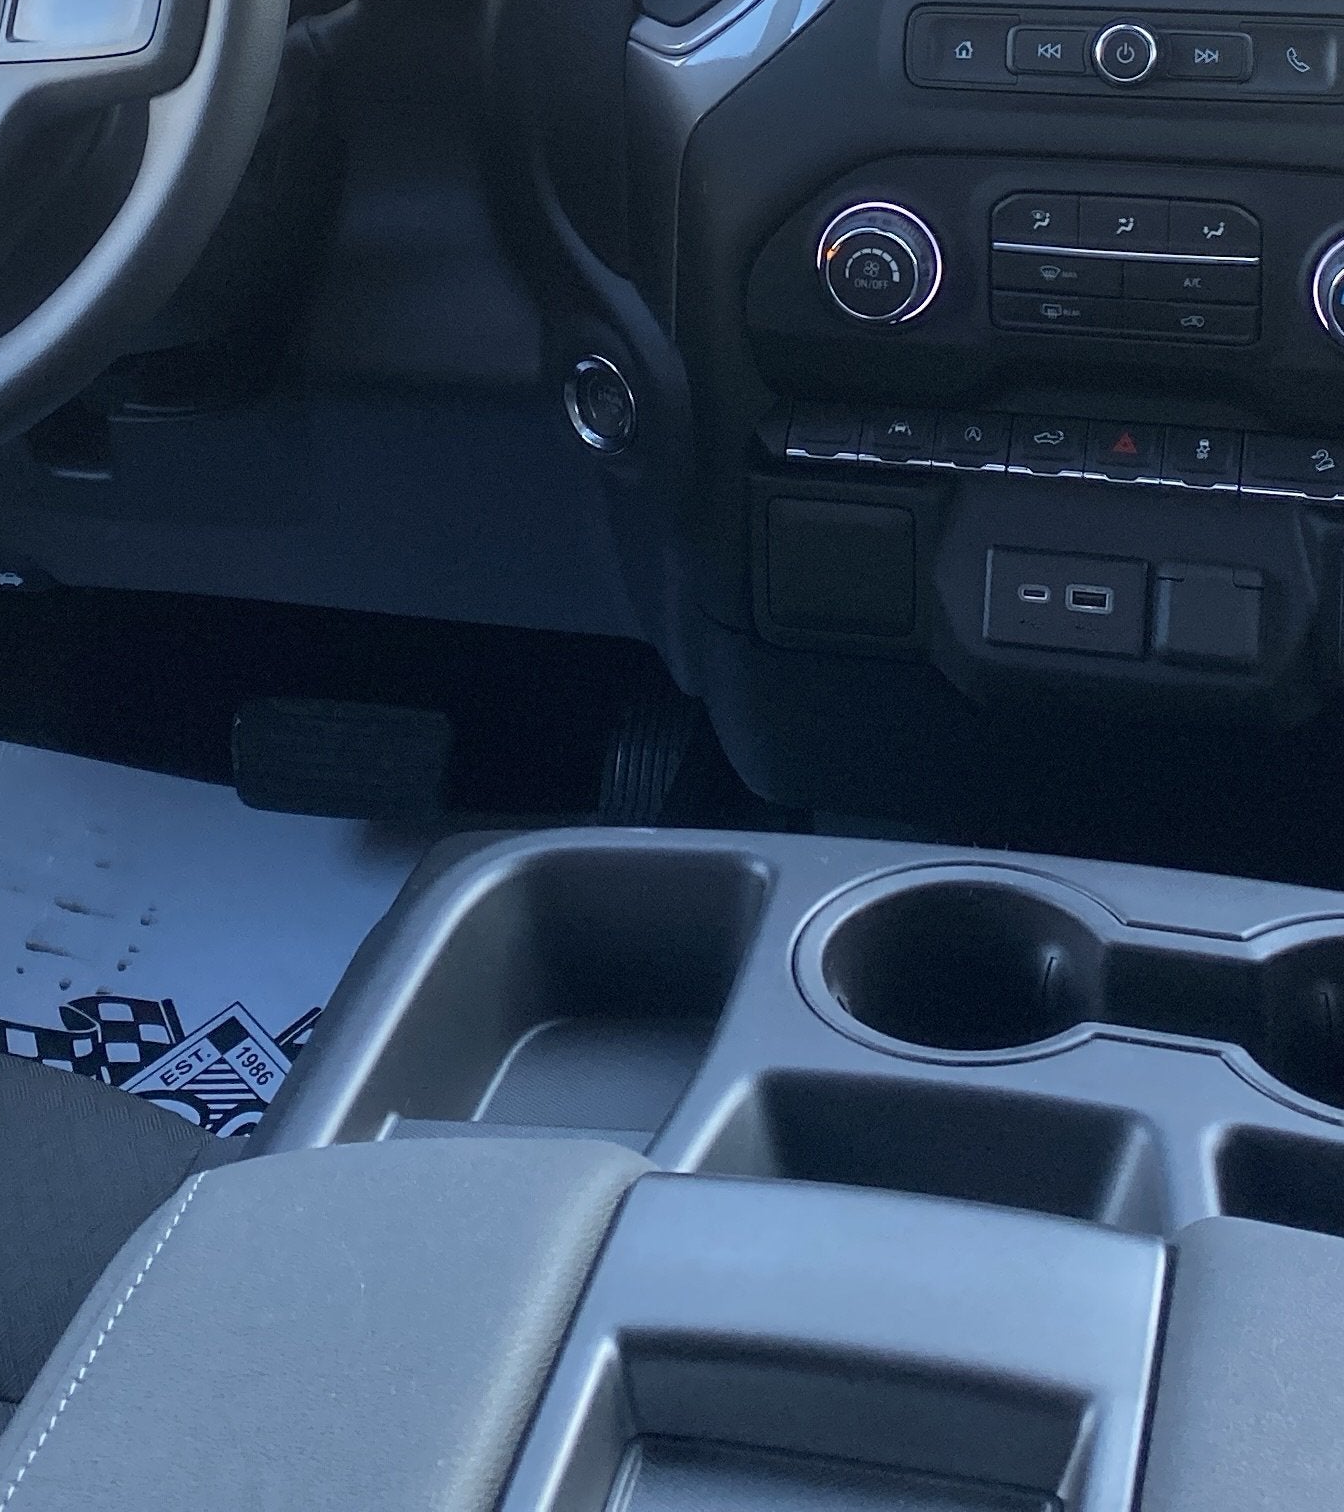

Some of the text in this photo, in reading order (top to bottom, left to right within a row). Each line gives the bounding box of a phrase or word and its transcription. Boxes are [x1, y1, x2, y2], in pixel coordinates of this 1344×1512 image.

[854, 279, 889, 290] ON/OFF
[1183, 278, 1202, 288] A/C
[159, 1046, 274, 1087] EST. 1986
